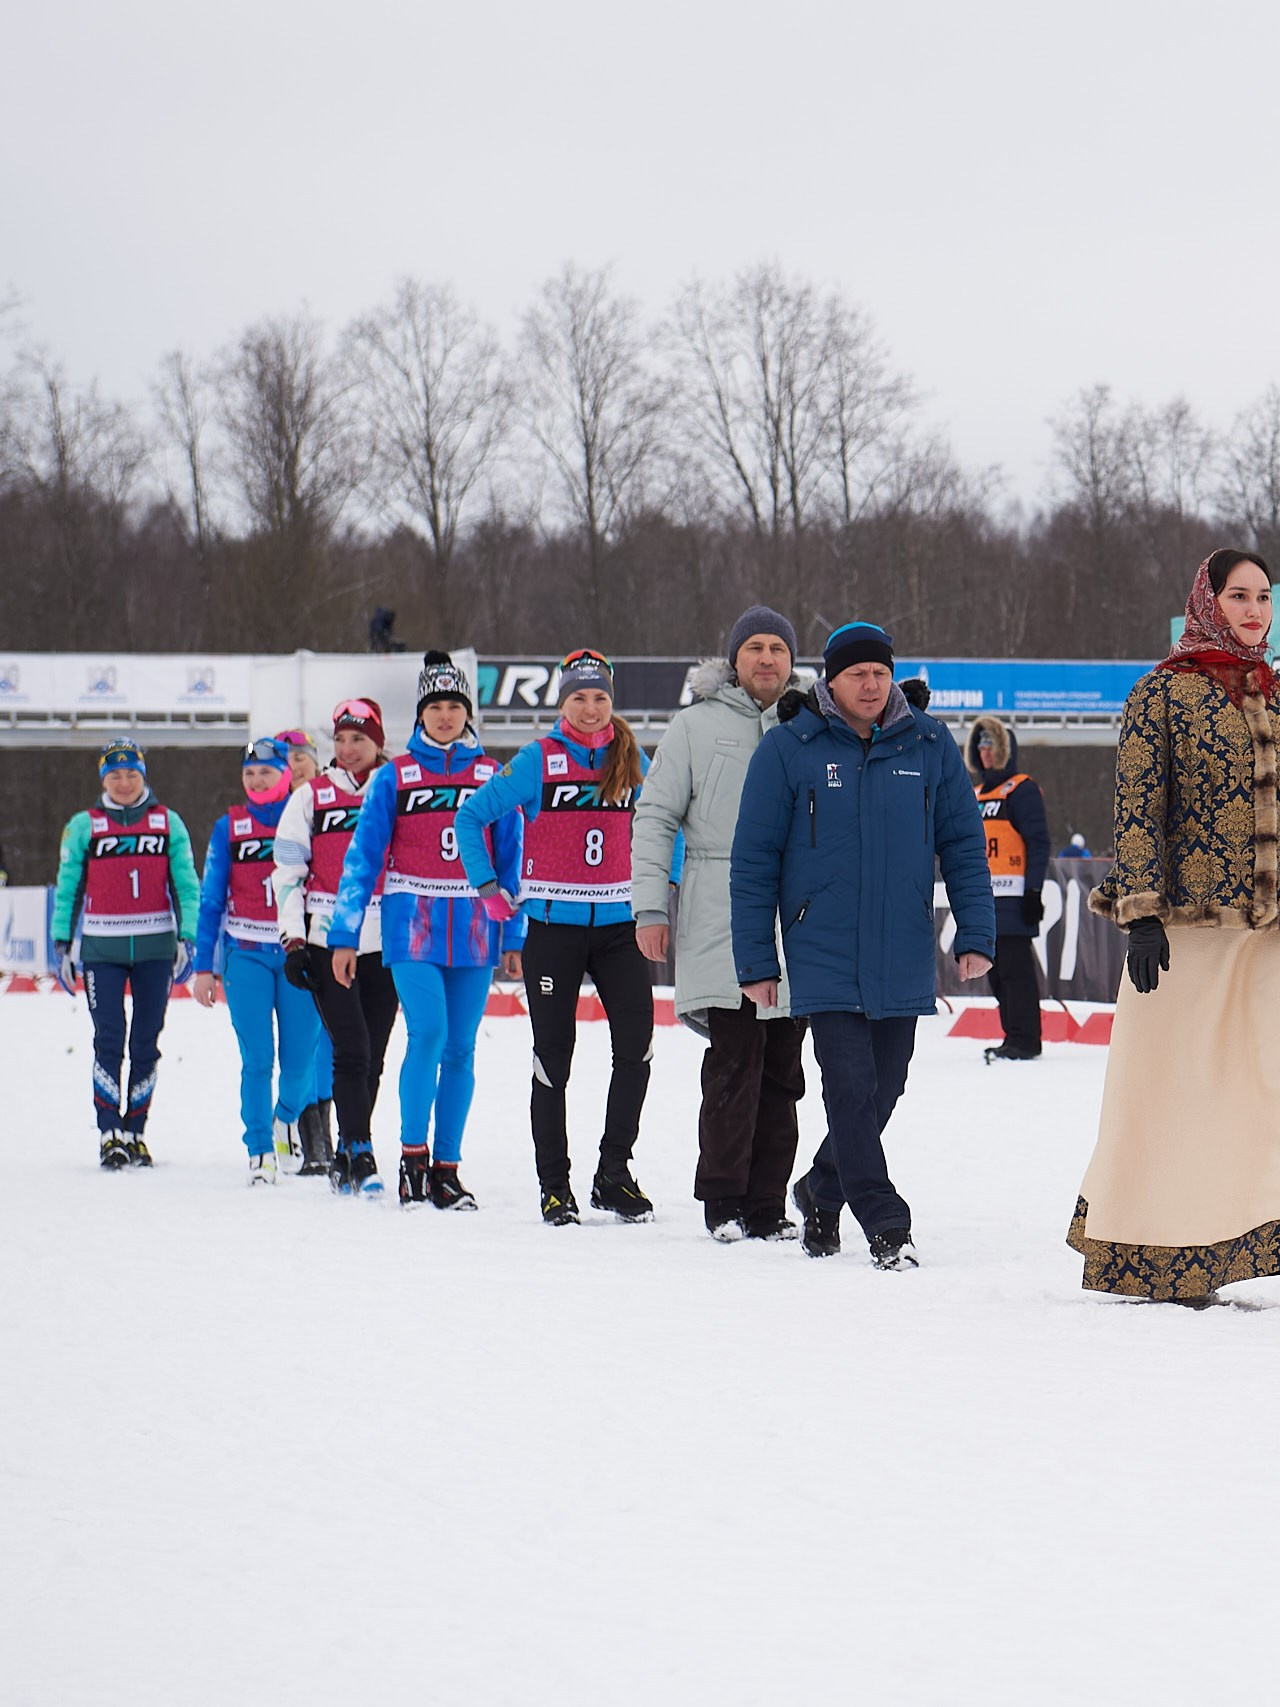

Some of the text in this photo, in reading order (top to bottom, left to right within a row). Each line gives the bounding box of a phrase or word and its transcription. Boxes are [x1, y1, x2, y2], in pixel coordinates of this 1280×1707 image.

[96, 835, 165, 857] PARI
[441, 827, 460, 861] 9
[585, 829, 604, 866] 8
[986, 838, 998, 858] Я
[526, 858, 534, 876] 8
[129, 868, 140, 899] 1
[408, 880, 469, 891] ЧЕМПИОНАТ
[548, 887, 614, 897] ЧЕМПИОНАТ
